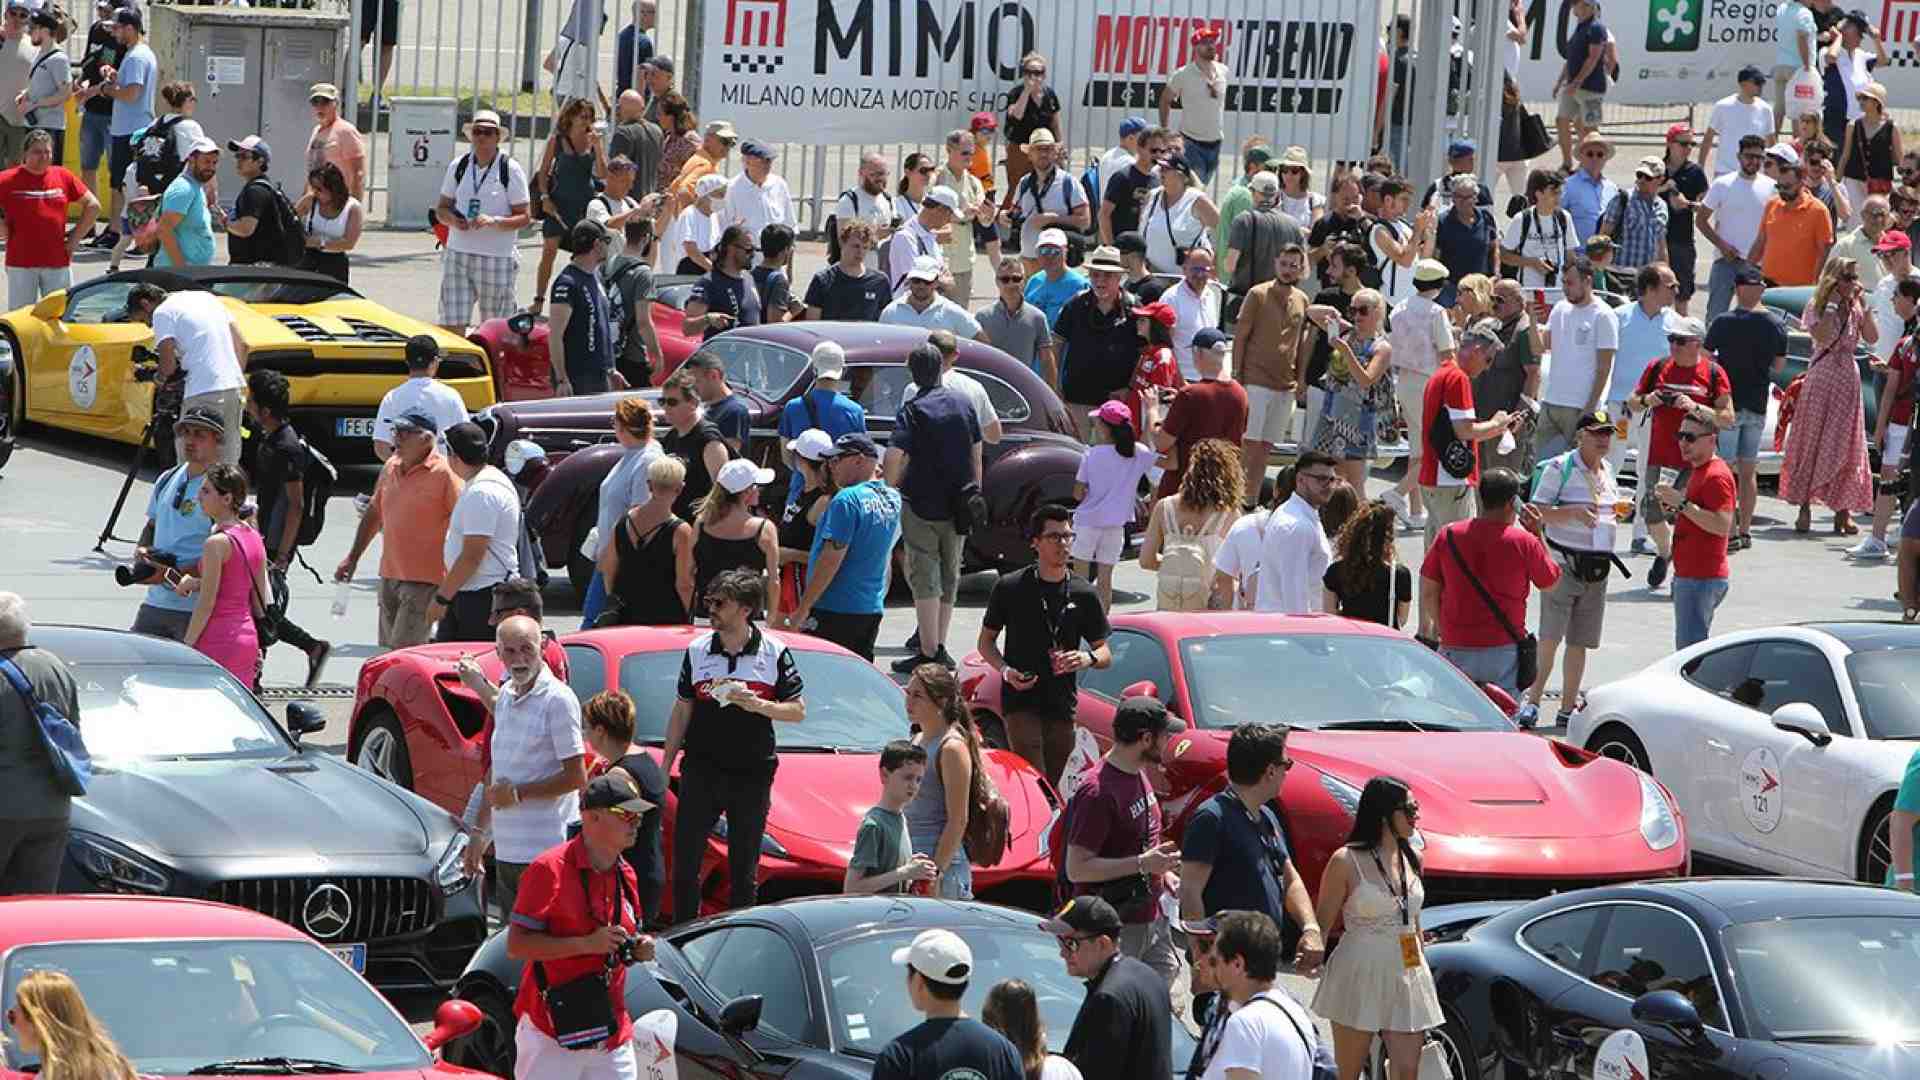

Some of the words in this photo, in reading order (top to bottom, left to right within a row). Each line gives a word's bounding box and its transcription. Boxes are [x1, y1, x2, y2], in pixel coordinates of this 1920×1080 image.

[814, 0, 1035, 81] MIMO
[720, 82, 805, 107] MILANO
[811, 86, 884, 110] MONZA
[891, 89, 961, 112] MOTOR
[413, 134, 430, 162] 6
[1752, 794, 1768, 813] 121
